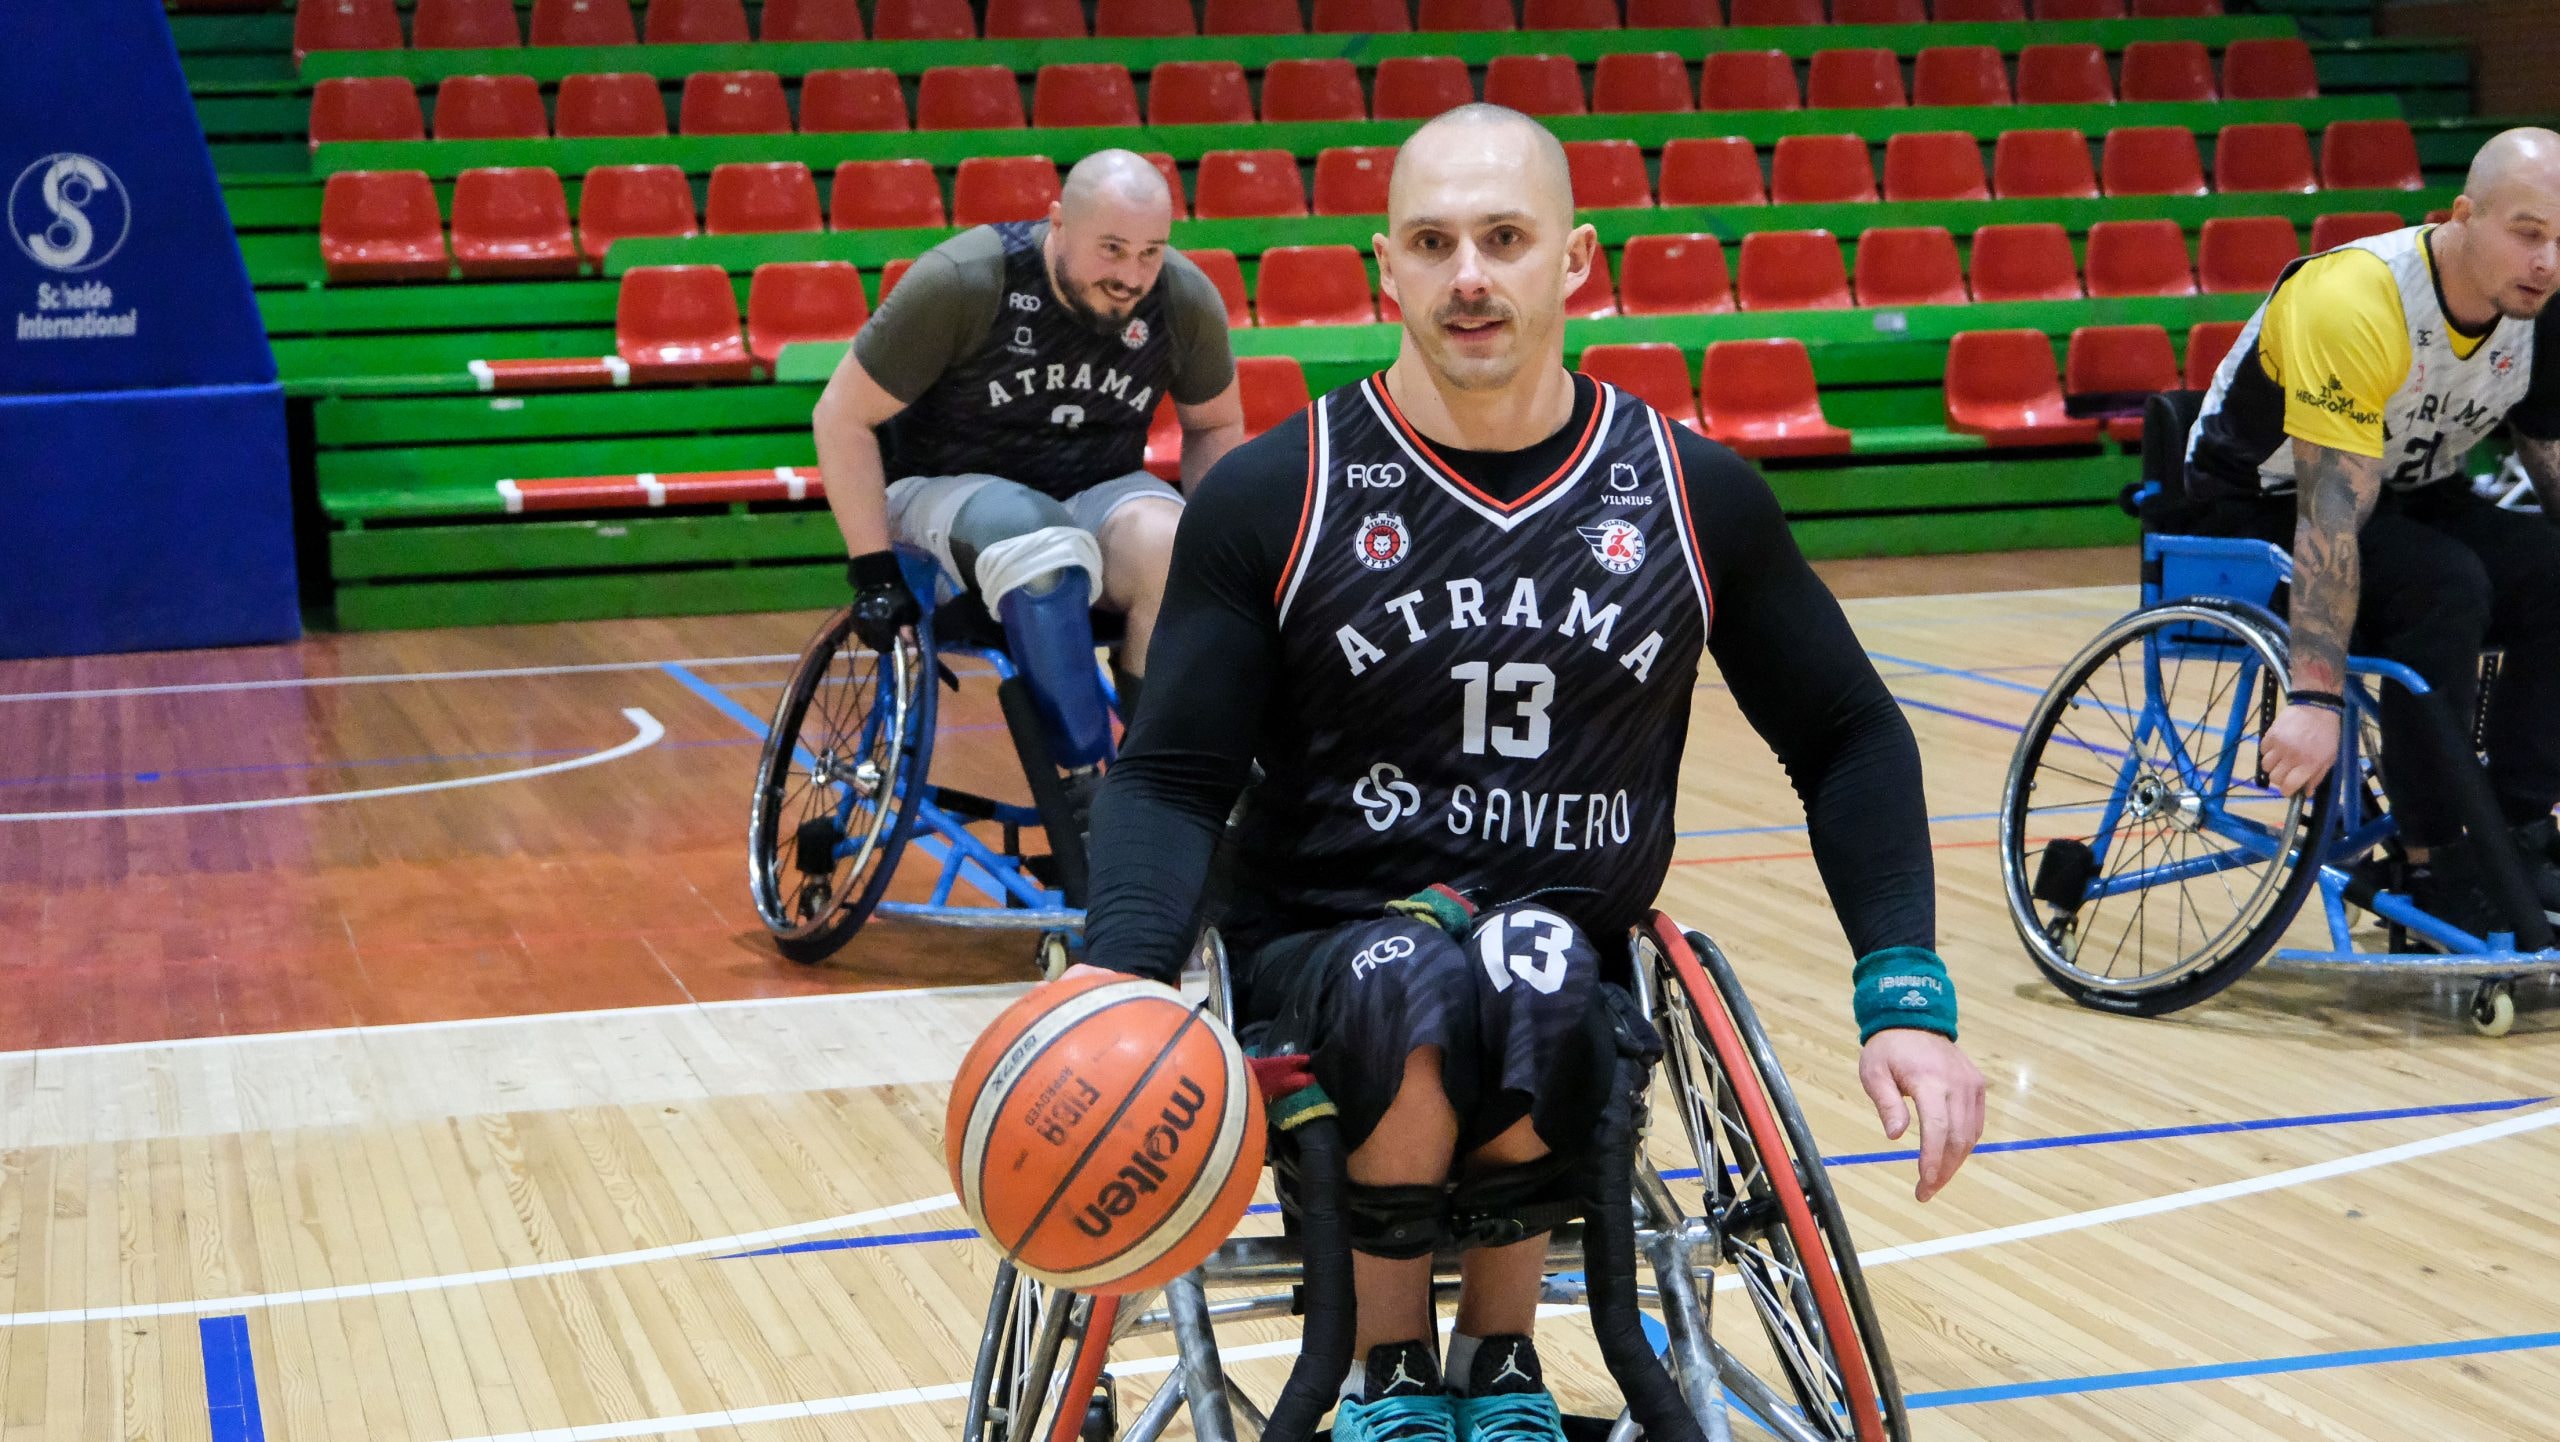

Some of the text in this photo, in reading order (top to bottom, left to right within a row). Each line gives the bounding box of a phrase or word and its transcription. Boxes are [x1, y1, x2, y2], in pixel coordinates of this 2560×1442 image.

[17, 308, 137, 339] International
[988, 363, 1152, 411] ATRAMA
[1600, 494, 1653, 505] VILNIUS
[1365, 519, 1399, 530] VILNIUS
[1602, 520, 1631, 529] VILNIUS
[1362, 554, 1402, 569] RYTAS
[1603, 532, 1645, 572] ATRAMA
[1335, 577, 1664, 683] ATRAMA
[1451, 661, 1556, 759] 13
[1447, 784, 1630, 850] SAVERO
[1472, 909, 1573, 994] 13
[1878, 975, 1943, 995] hummel
[1024, 1064, 1074, 1126] APPROVED
[1073, 1075, 1206, 1238] molten
